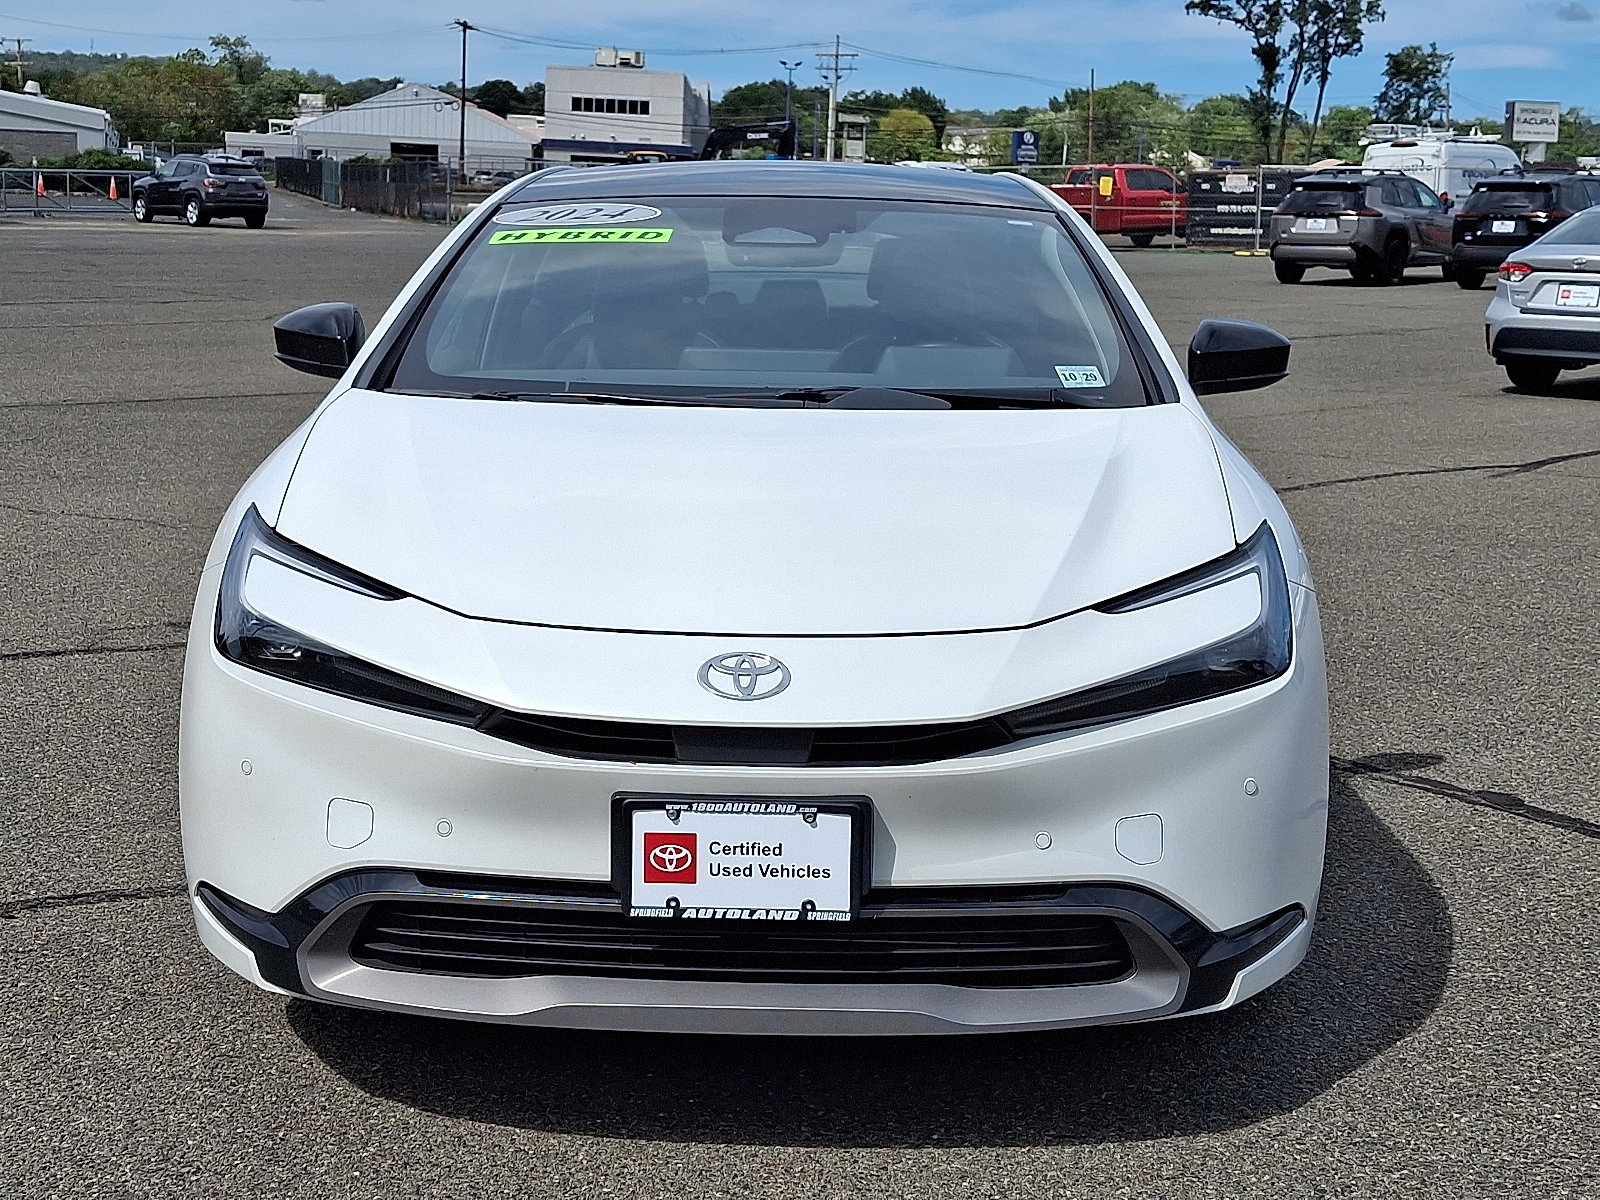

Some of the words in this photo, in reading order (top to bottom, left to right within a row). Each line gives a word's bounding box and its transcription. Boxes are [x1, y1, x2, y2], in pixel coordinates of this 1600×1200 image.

[1522, 117, 1556, 126] ACURA
[515, 207, 635, 223] 2024
[498, 231, 664, 242] HYBRID
[1061, 372, 1078, 382] 10
[1082, 372, 1098, 382] 29
[666, 802, 818, 814] www.1800AUTOLAND.com
[708, 841, 783, 857] Certified
[709, 862, 753, 877] Used
[758, 863, 831, 879] Vehicles
[630, 908, 674, 917] SPRINGFIELD
[681, 908, 800, 921] AUTOLAND
[807, 911, 851, 921] SPRINGFIELD
